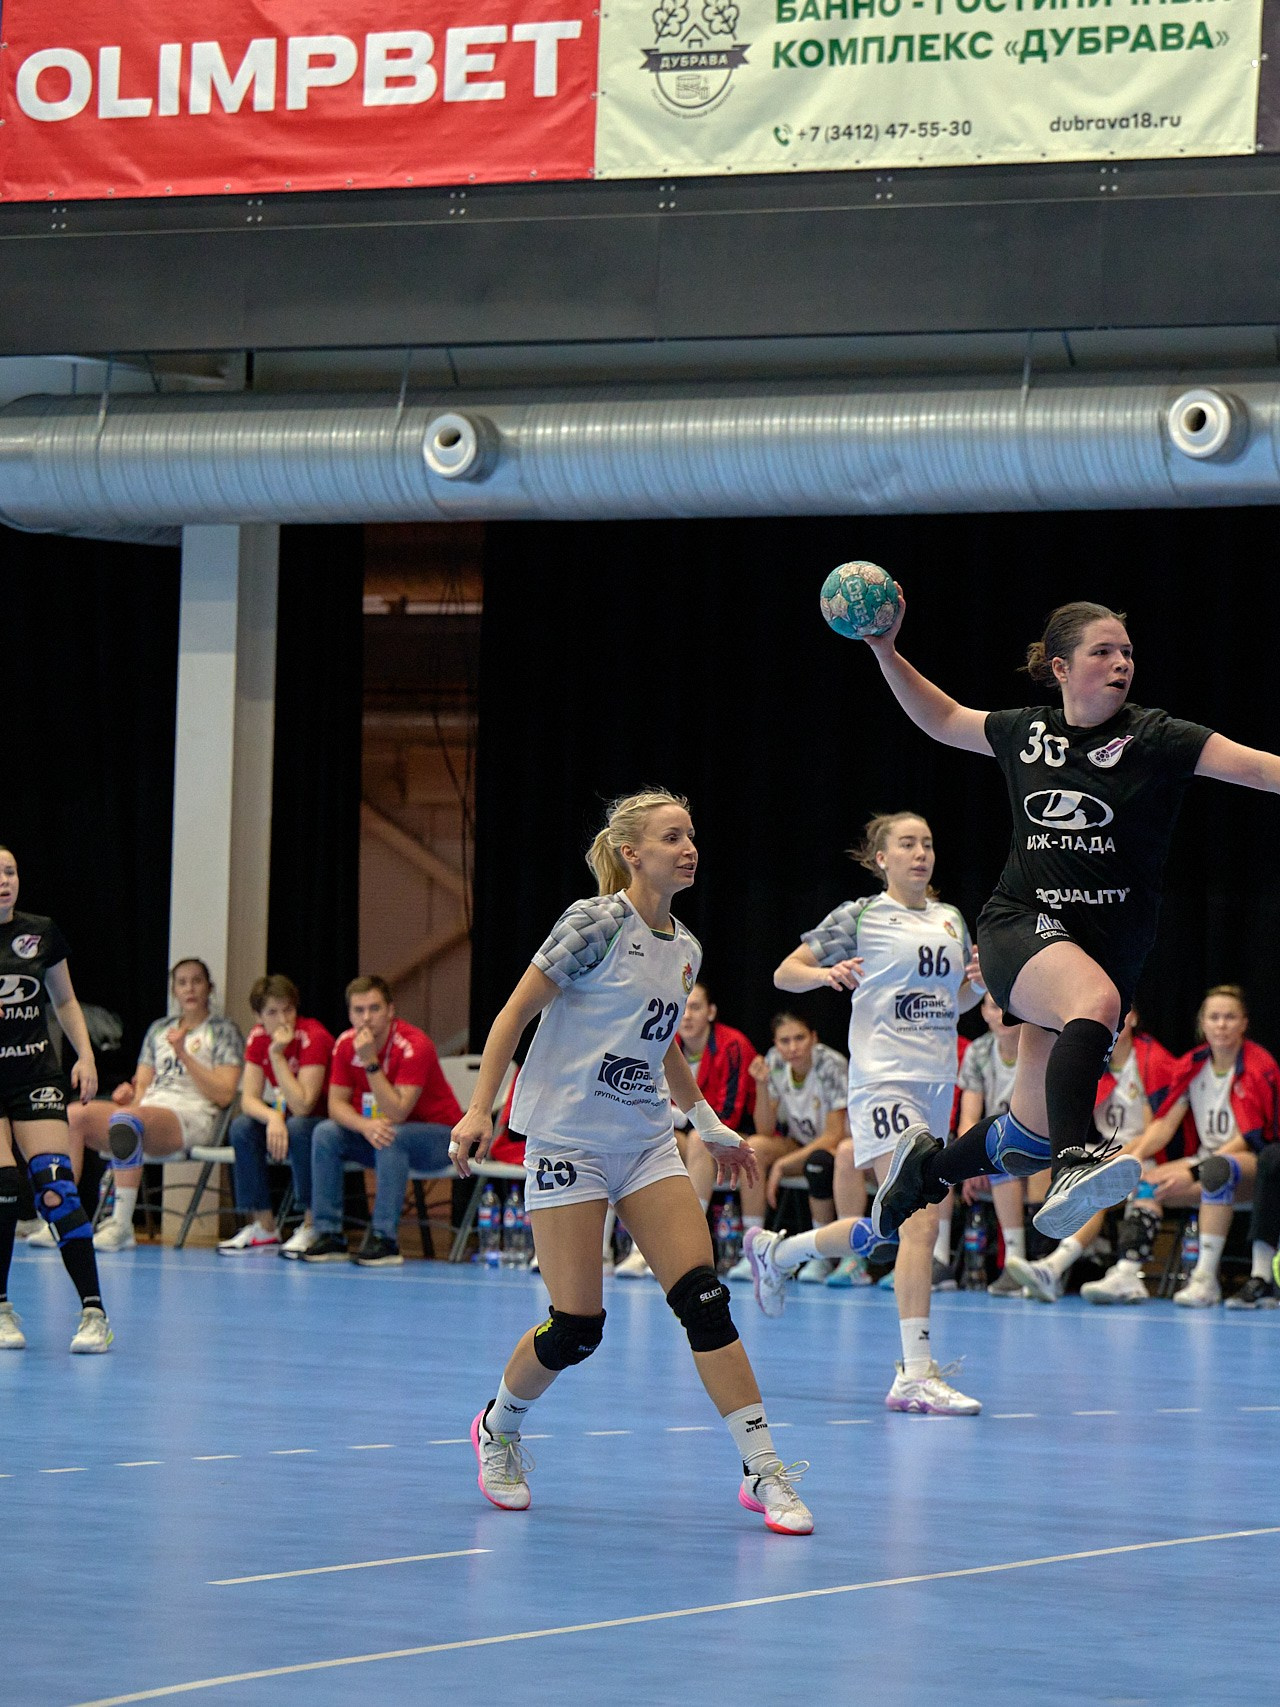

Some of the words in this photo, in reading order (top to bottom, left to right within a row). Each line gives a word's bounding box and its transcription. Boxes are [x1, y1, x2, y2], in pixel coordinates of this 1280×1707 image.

[776, 0, 901, 24] БАННО
[772, 31, 994, 69] КОМПЛЕКС
[1004, 21, 1230, 64] «ДУБРАВА»
[16, 20, 583, 122] OLIMPBET
[660, 53, 729, 70] ДУБРАВА
[797, 126, 821, 143] +7
[824, 124, 880, 144] (3412)
[885, 120, 973, 139] 47-55-30
[1049, 112, 1182, 133] dubrava18.ru
[1019, 721, 1070, 768] 30
[1026, 833, 1117, 854] ИЖ-ЛАДА
[918, 945, 951, 978] 86
[640, 998, 679, 1042] 23
[594, 1090, 620, 1103] ГРУППА
[872, 1103, 910, 1140] 86
[1106, 1104, 1125, 1128] 67
[1207, 1110, 1230, 1135] 10
[699, 1287, 723, 1302] SELECT
[745, 1423, 768, 1433] erima
